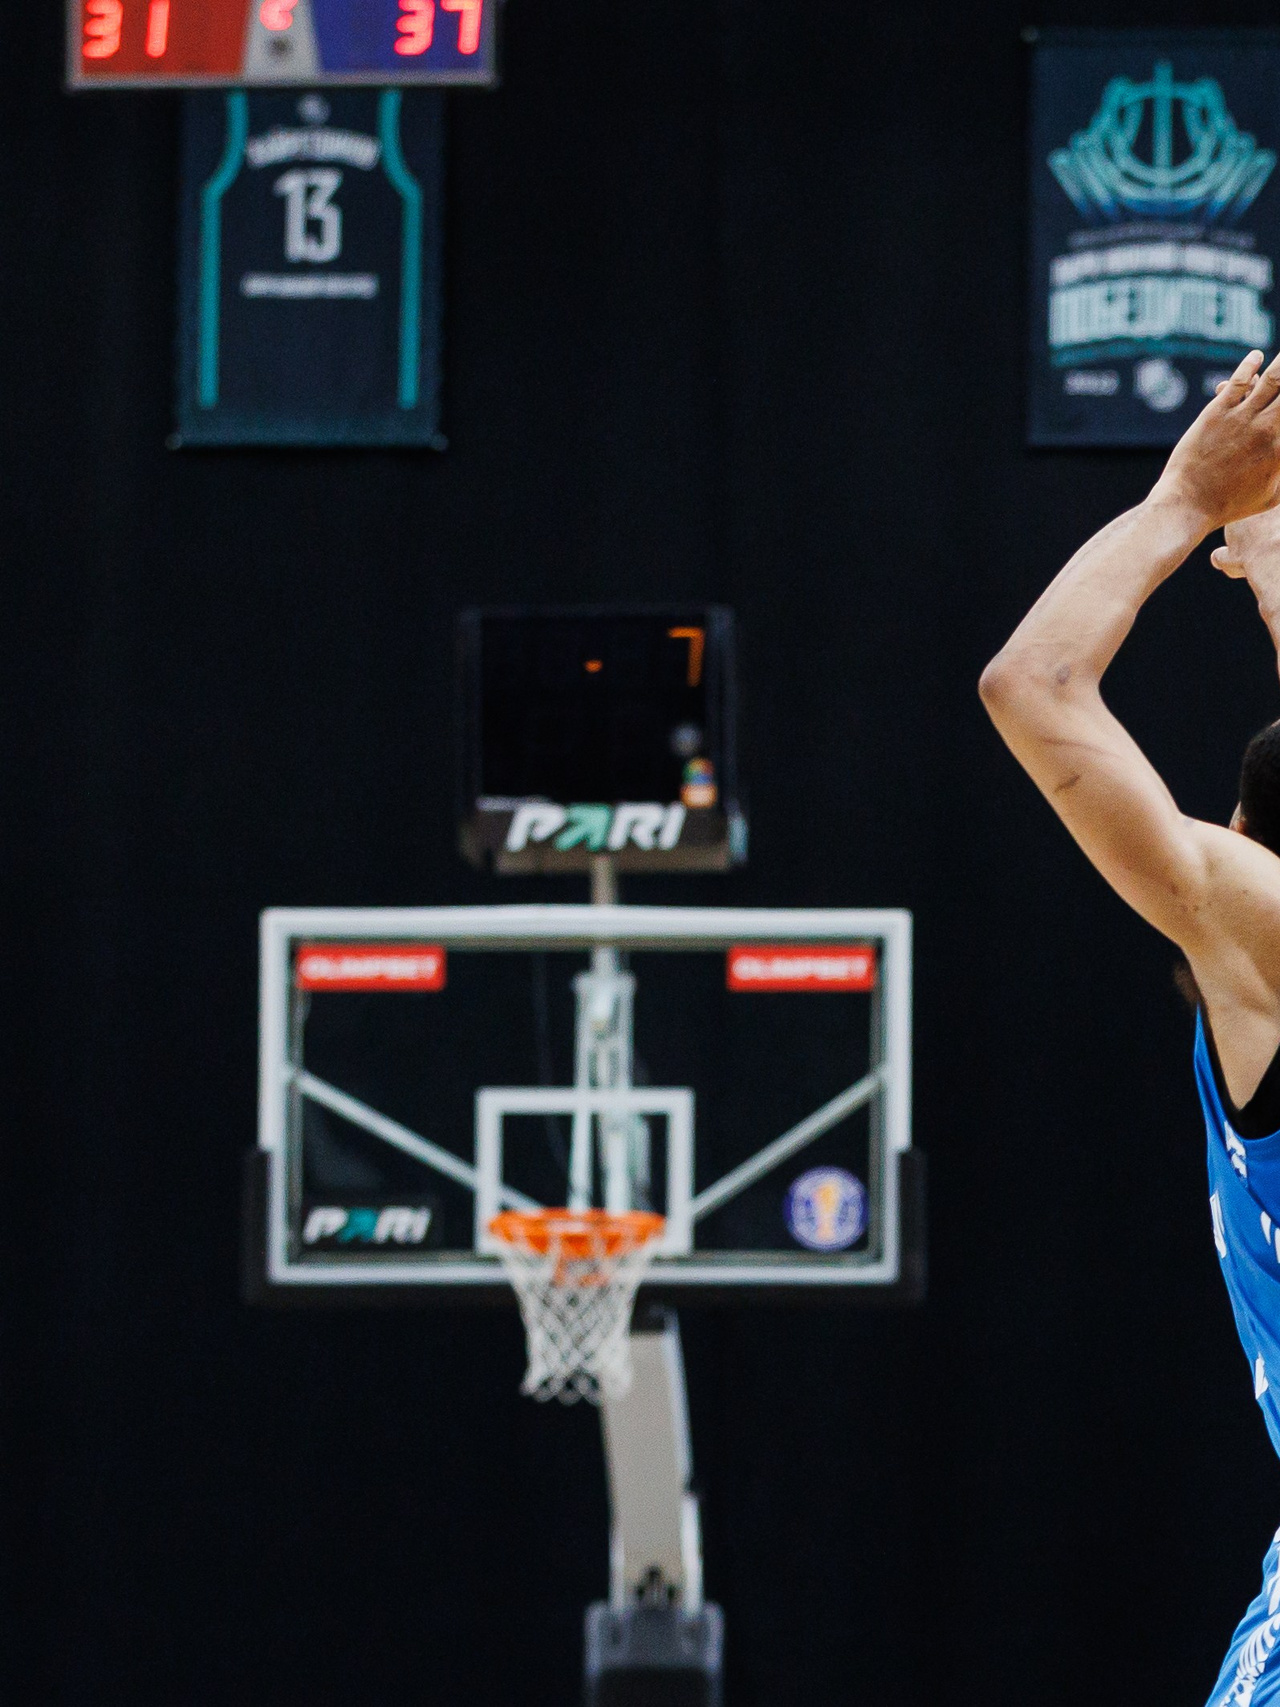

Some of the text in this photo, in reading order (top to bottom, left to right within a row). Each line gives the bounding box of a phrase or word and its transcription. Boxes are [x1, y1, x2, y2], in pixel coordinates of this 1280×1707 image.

[82, 0, 170, 58] 31
[273, 167, 343, 263] 13
[668, 627, 705, 687] 7
[505, 802, 688, 852] PARI
[303, 1204, 432, 1245] PARI
